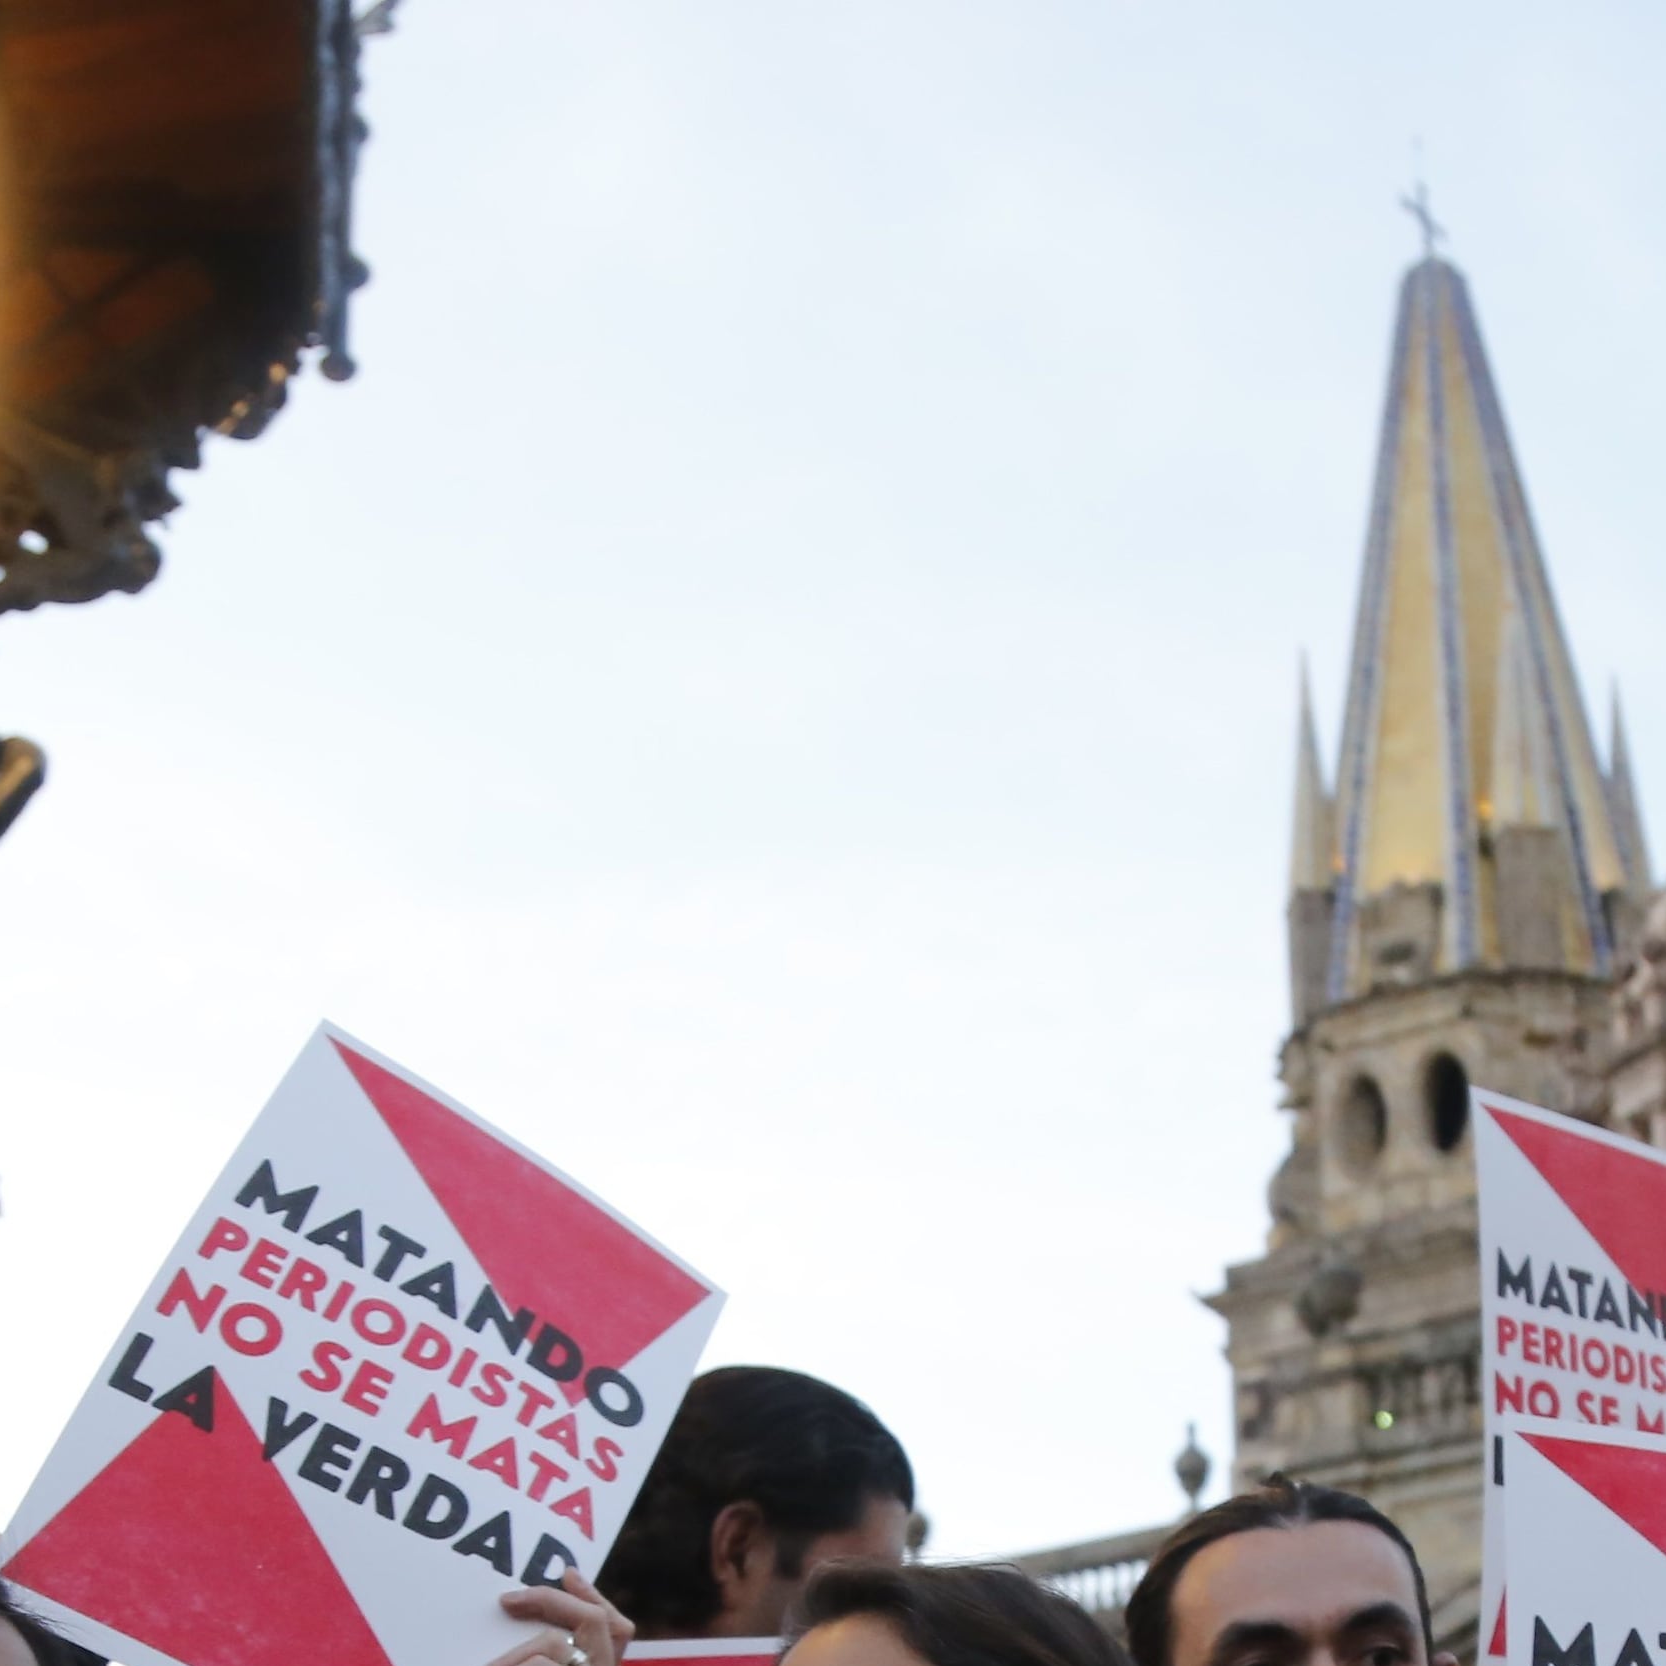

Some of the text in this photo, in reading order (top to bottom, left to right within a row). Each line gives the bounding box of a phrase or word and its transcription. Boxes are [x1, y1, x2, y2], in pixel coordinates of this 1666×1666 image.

[155, 1267, 596, 1542] NO SE MATA
[198, 1216, 625, 1483] PERIODISTAS
[235, 1159, 644, 1427] MATANDO
[1495, 1370, 1560, 1418] NO
[1576, 1390, 1620, 1426] SE
[107, 1333, 579, 1592] LA VERDAD
